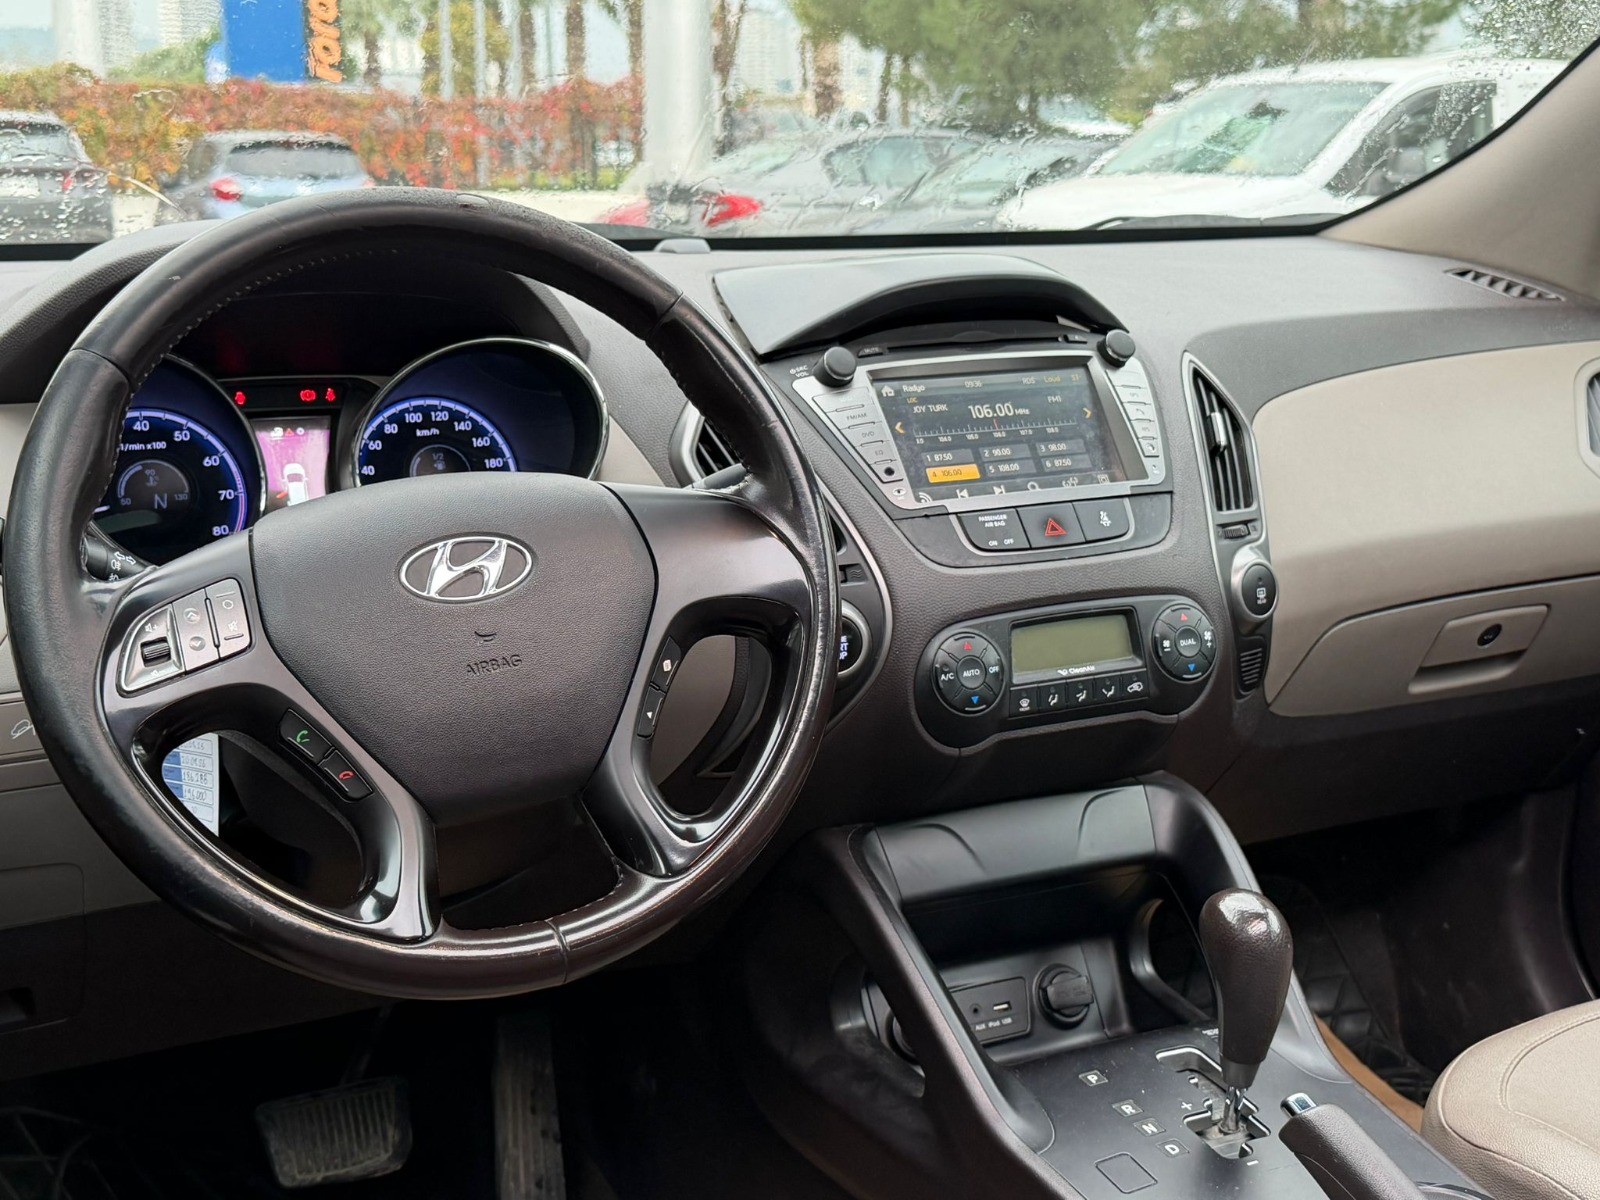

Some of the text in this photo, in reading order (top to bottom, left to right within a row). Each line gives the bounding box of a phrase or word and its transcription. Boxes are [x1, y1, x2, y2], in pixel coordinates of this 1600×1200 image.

[902, 384, 926, 393] Radyo
[913, 403, 948, 413] JOY TURK
[967, 402, 1014, 419] 106.00
[404, 412, 423, 423] 100
[430, 411, 449, 422] 120
[133, 420, 150, 431] 40
[384, 423, 398, 434] 80
[453, 420, 472, 431] 140
[174, 430, 190, 441] 50
[416, 427, 440, 437] km/h
[146, 441, 167, 450] x100
[368, 440, 382, 450] 60
[472, 436, 490, 448] 160
[203, 456, 220, 467] 60
[484, 458, 503, 469] 180
[361, 465, 375, 476] 40
[218, 489, 235, 501] 70
[155, 493, 168, 509] N
[212, 525, 229, 536] 80
[1180, 638, 1197, 647] DUAL
[466, 653, 523, 677] AIRBAG
[988, 665, 999, 673] OFF
[940, 672, 955, 681] A/C
[962, 668, 981, 678] AUTO
[1087, 1074, 1098, 1084] P
[1120, 1103, 1136, 1115] R
[1141, 1123, 1158, 1134] N
[1164, 1144, 1180, 1155] D
